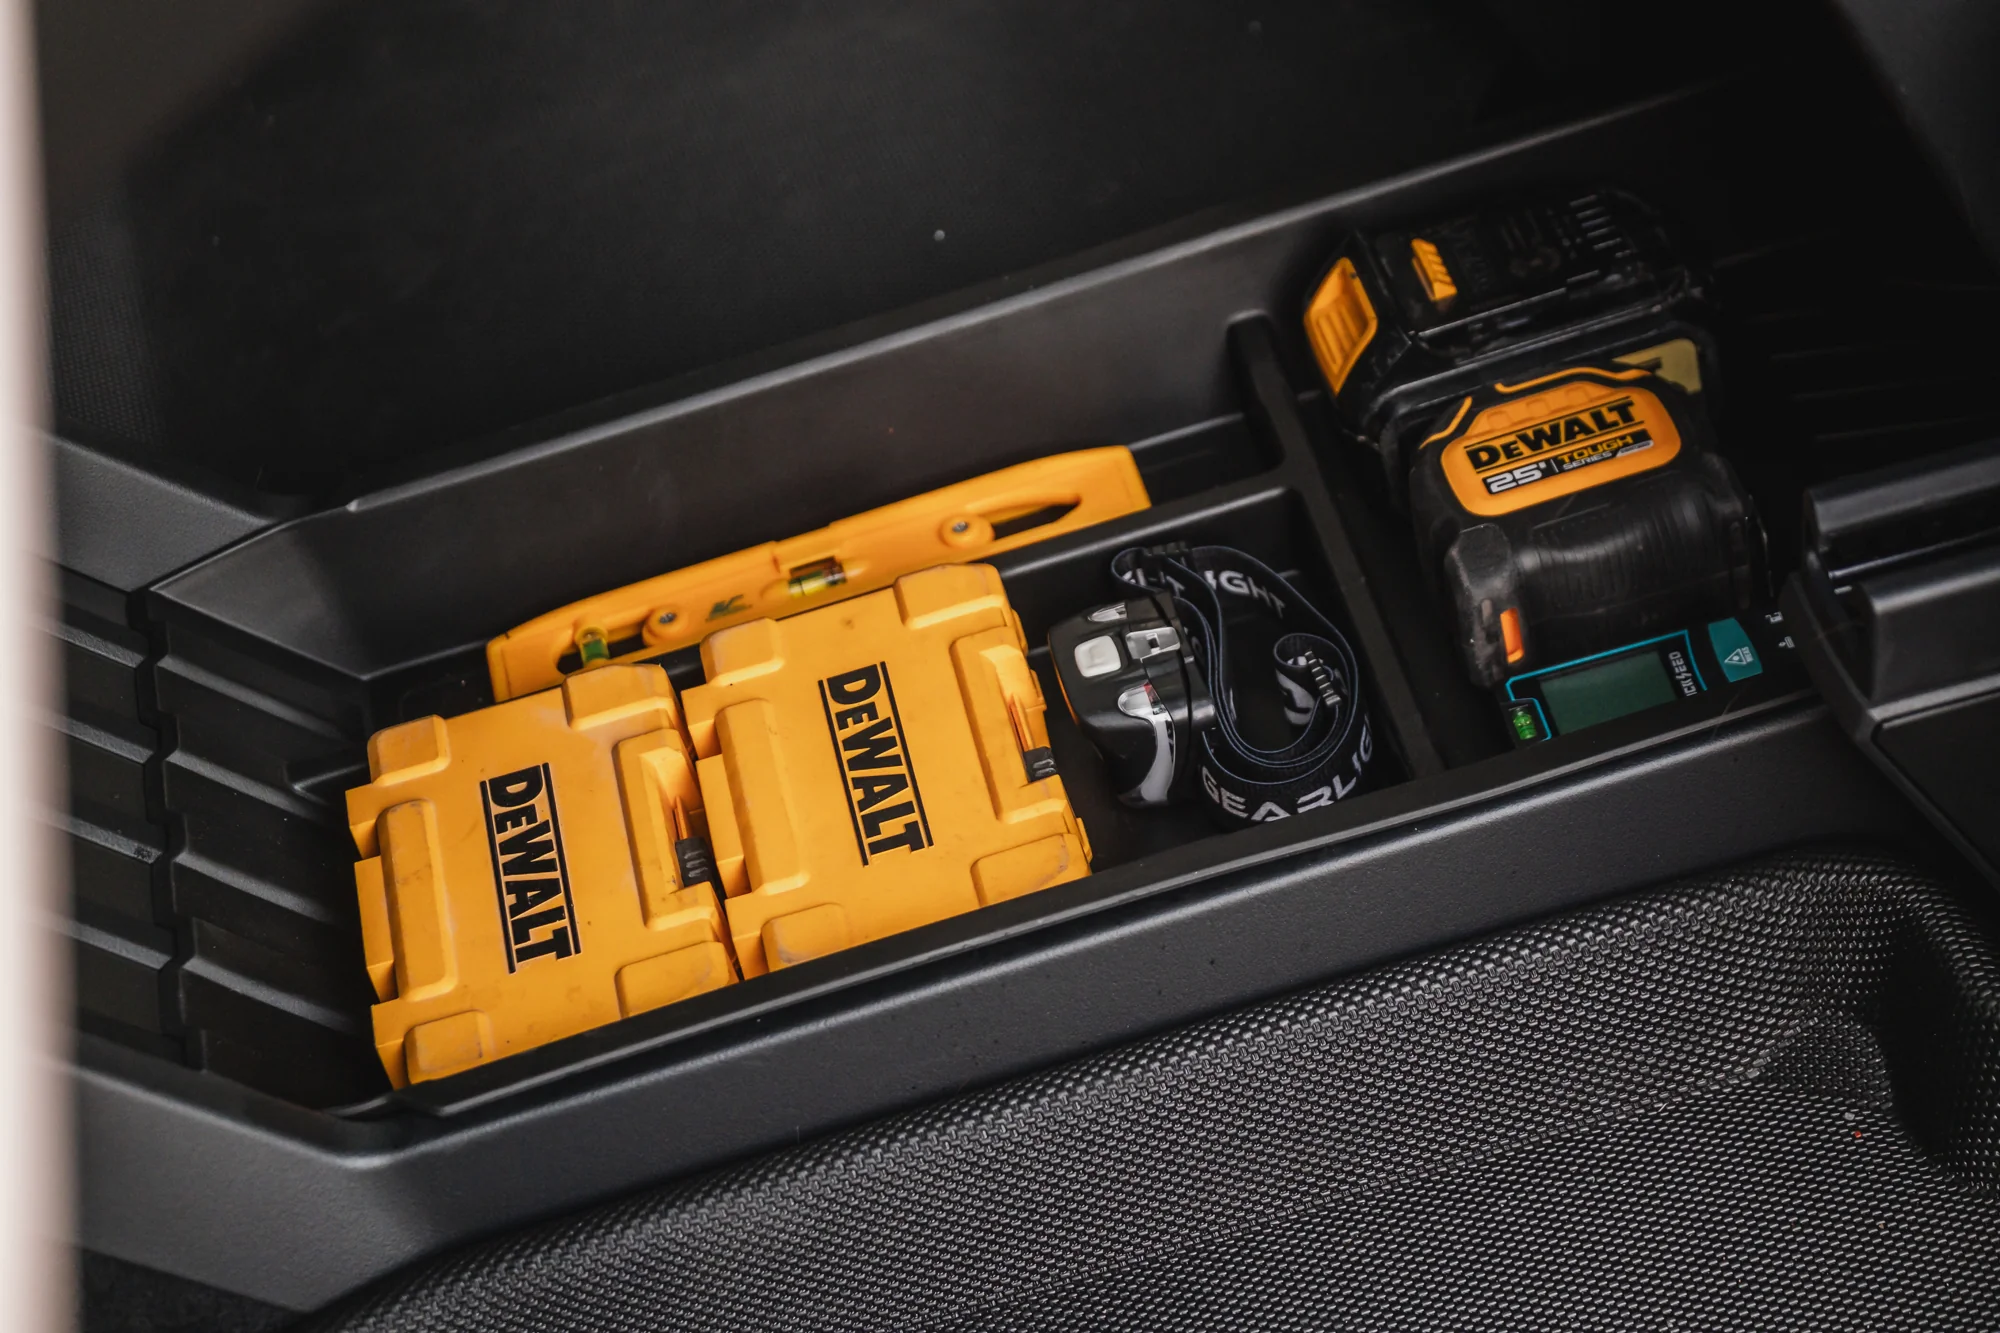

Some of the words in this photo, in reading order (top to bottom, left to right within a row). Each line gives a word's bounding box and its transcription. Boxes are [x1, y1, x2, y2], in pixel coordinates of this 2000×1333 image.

[1466, 401, 1635, 469] DEWALT
[1557, 435, 1634, 463] TOUGH
[1563, 451, 1613, 470] SERIES
[827, 664, 925, 855] DEWALT
[1202, 714, 1373, 821] GEARLIG
[488, 765, 572, 963] DEWALT
